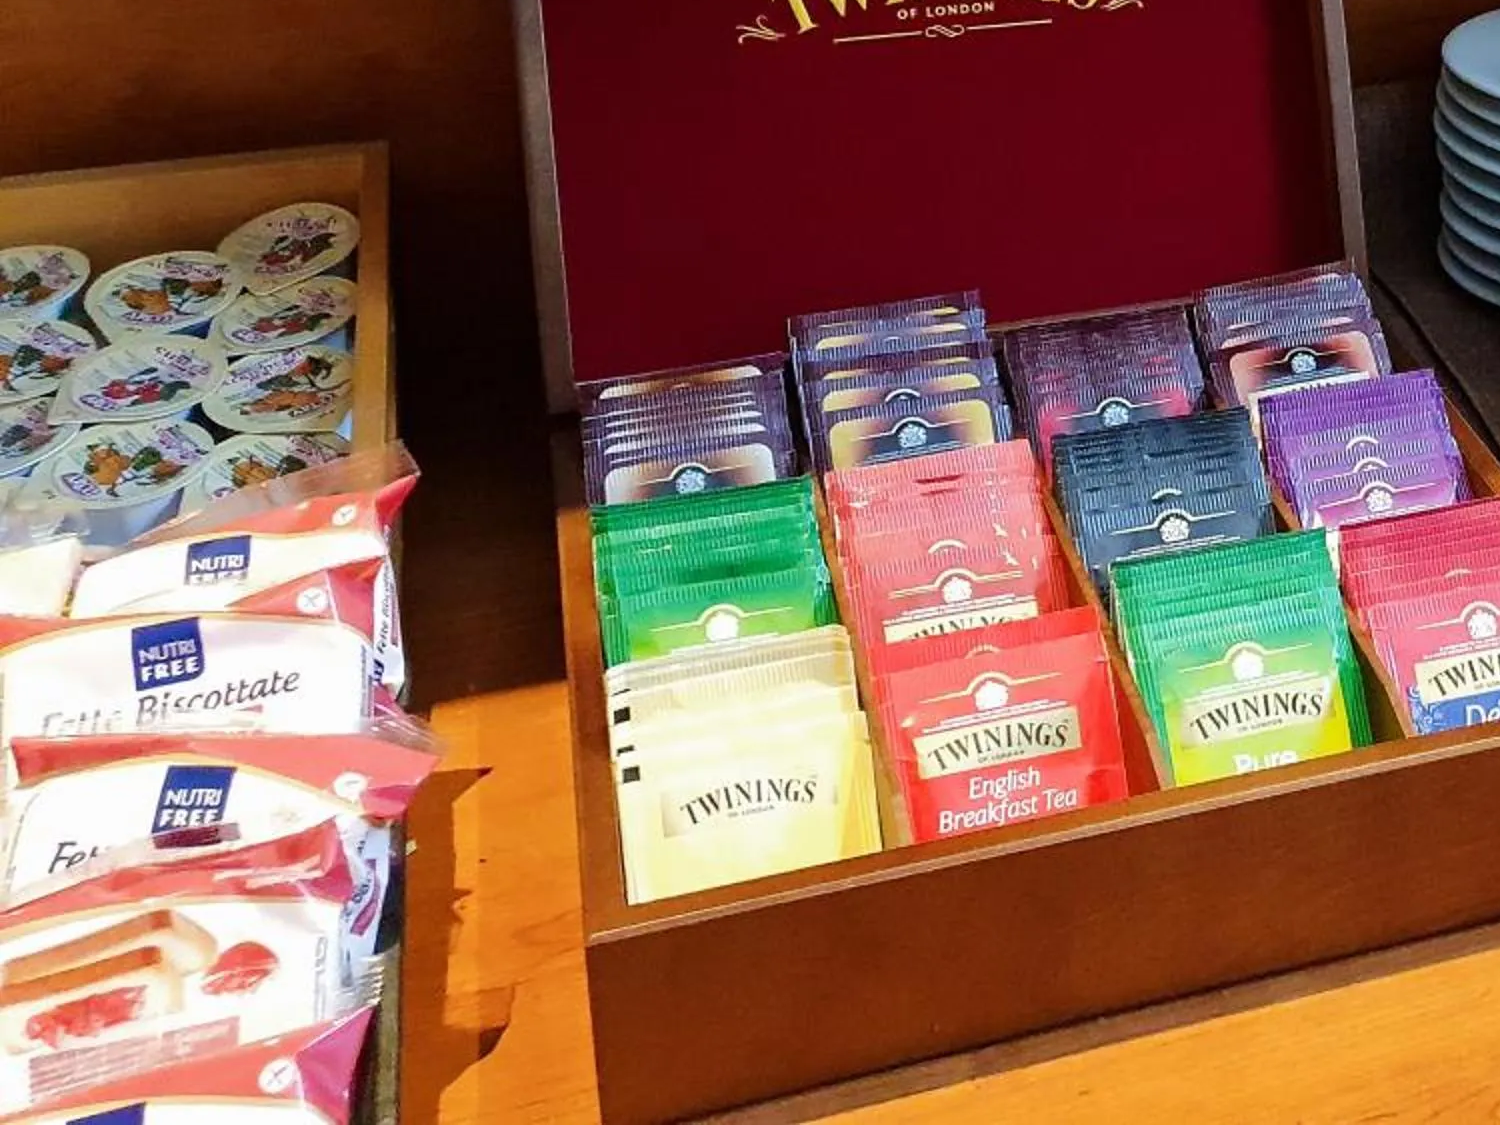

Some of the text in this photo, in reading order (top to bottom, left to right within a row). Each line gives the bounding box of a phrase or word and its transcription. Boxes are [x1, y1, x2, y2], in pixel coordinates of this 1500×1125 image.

[897, 1, 996, 20] OF LONDON
[191, 554, 246, 573] NUTRI
[138, 639, 197, 664] NUTRI
[140, 655, 201, 683] FREE
[135, 670, 301, 733] Biscottate
[1190, 690, 1324, 740] TWININGS
[927, 721, 1069, 771] TWININGS
[165, 788, 223, 807] NUTRI
[680, 777, 817, 825] TWININGS
[968, 765, 1041, 801] English
[937, 786, 1078, 834] Breakfast Tea
